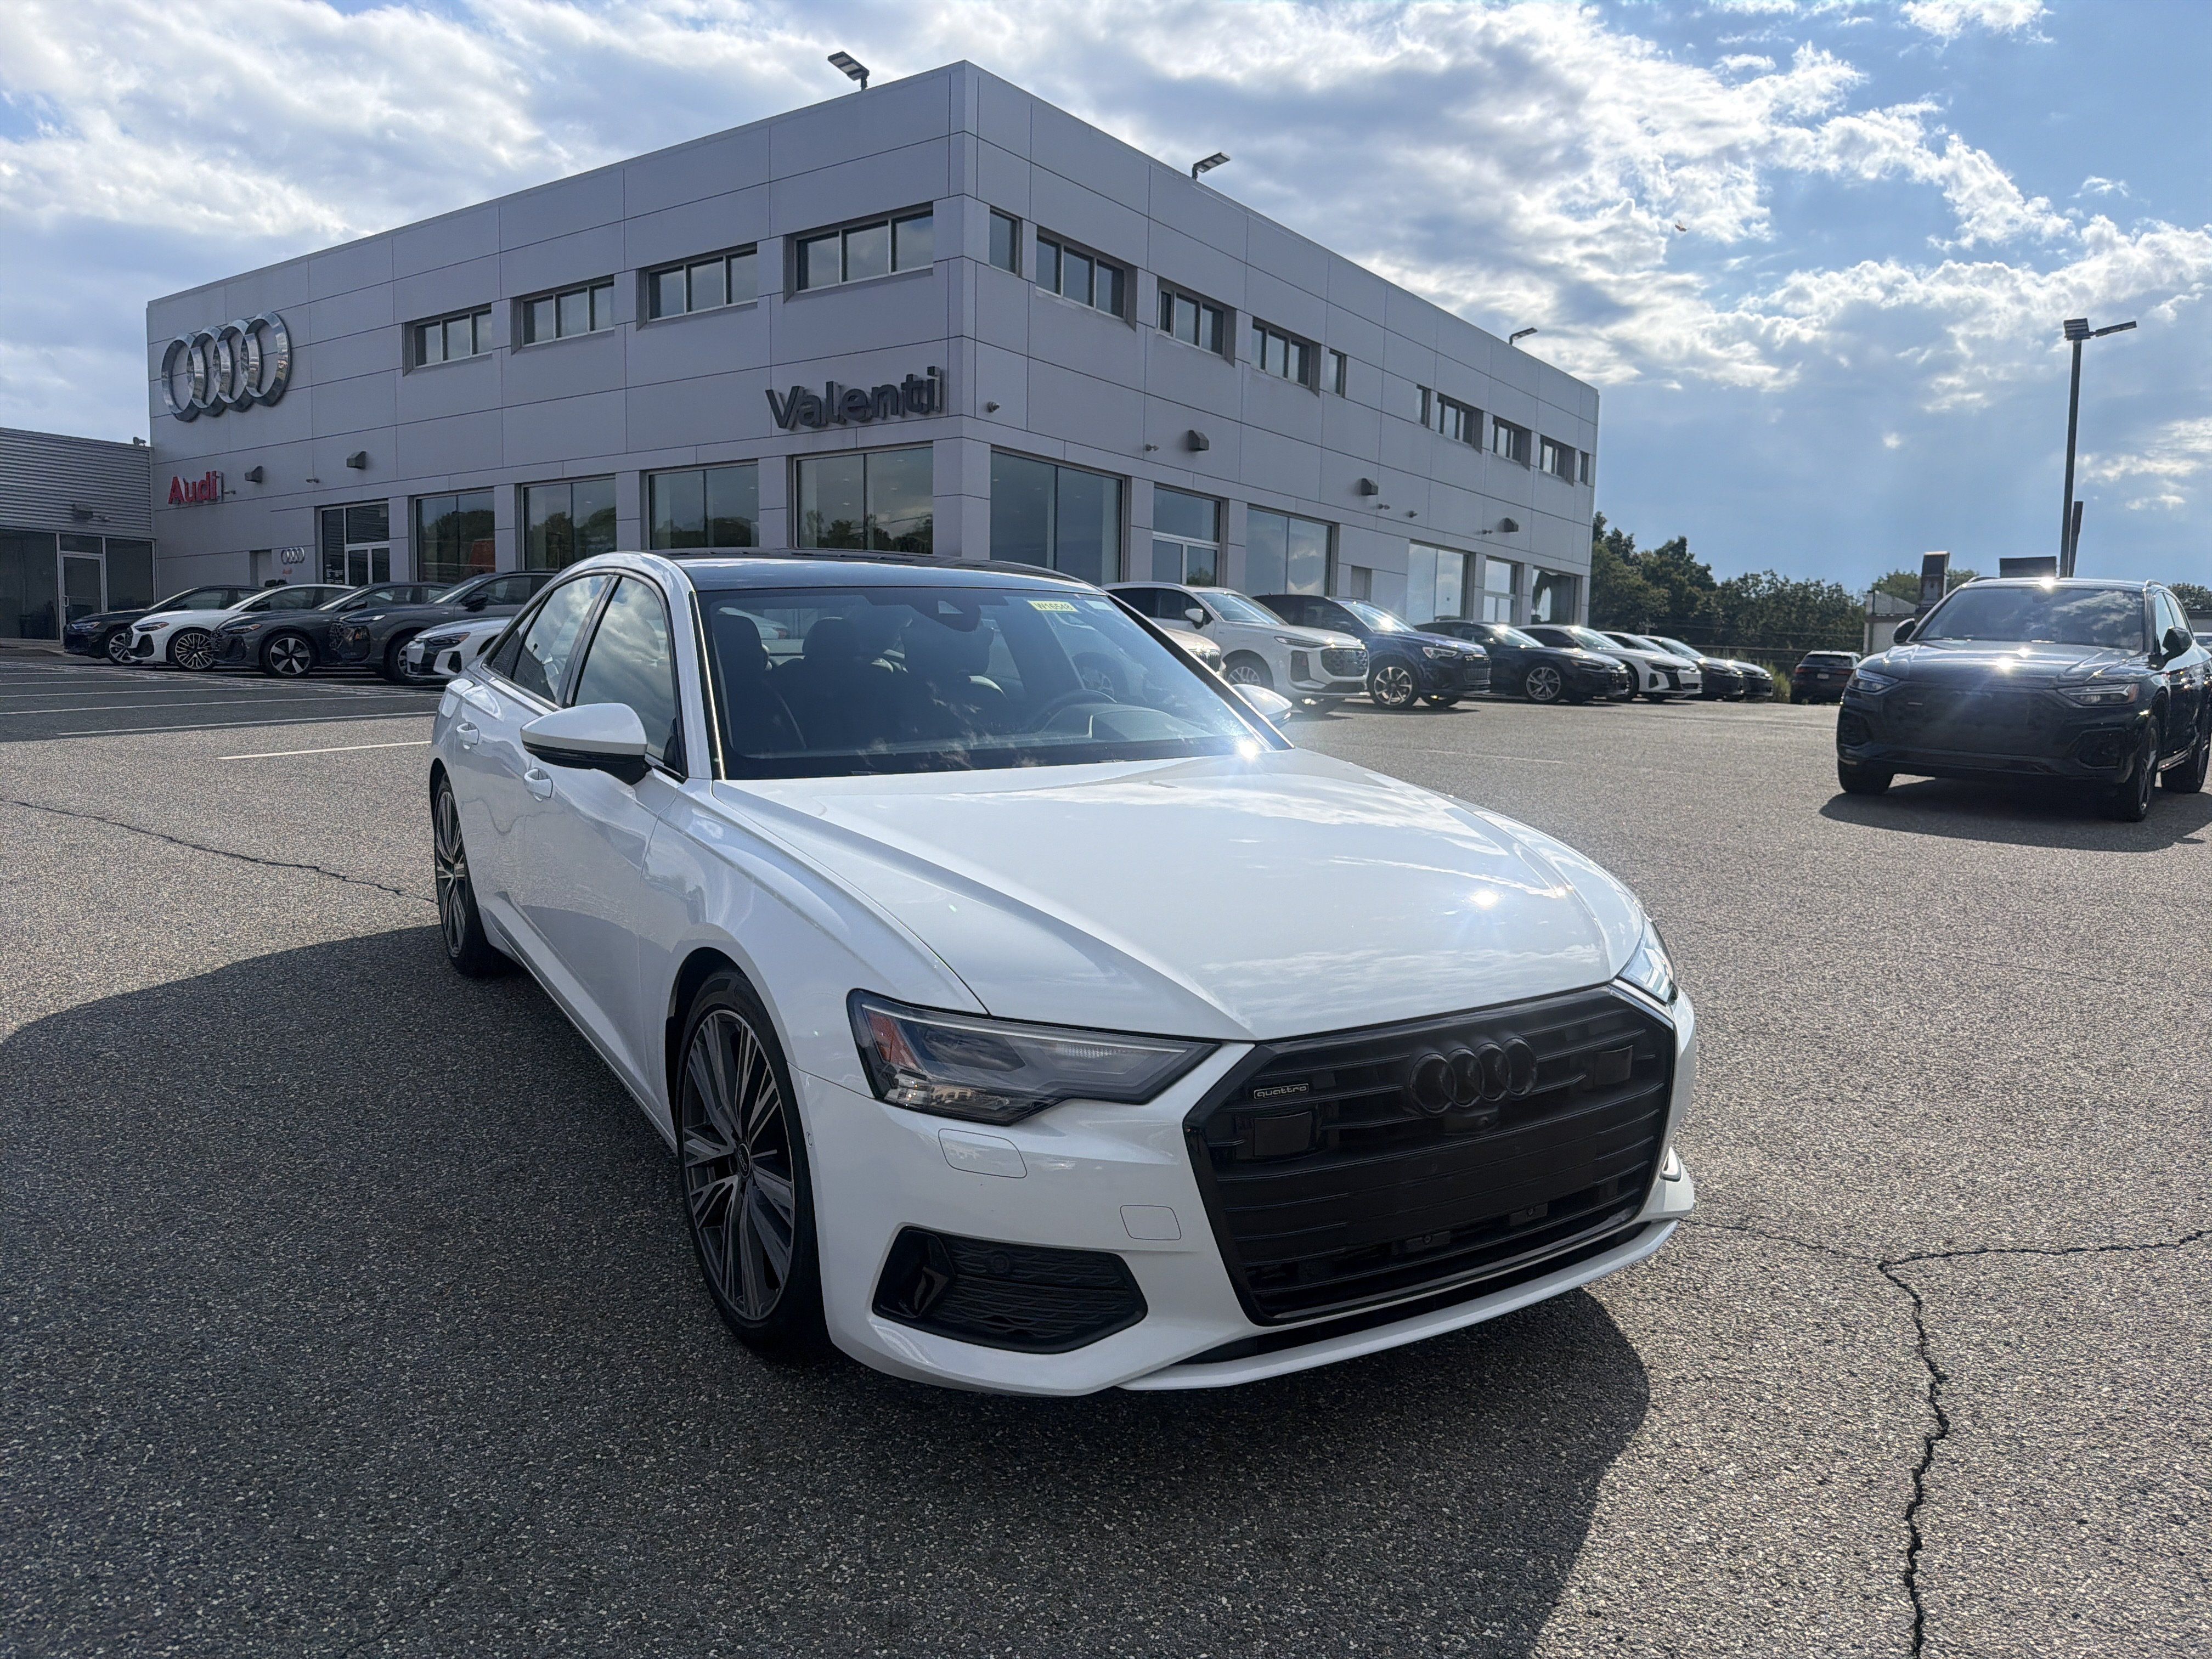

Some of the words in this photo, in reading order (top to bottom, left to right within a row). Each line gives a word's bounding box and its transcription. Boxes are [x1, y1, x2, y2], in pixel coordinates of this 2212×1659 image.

[765, 366, 940, 428] Valenti
[168, 471, 218, 504] Audi
[1257, 1086, 1307, 1097] quattro
